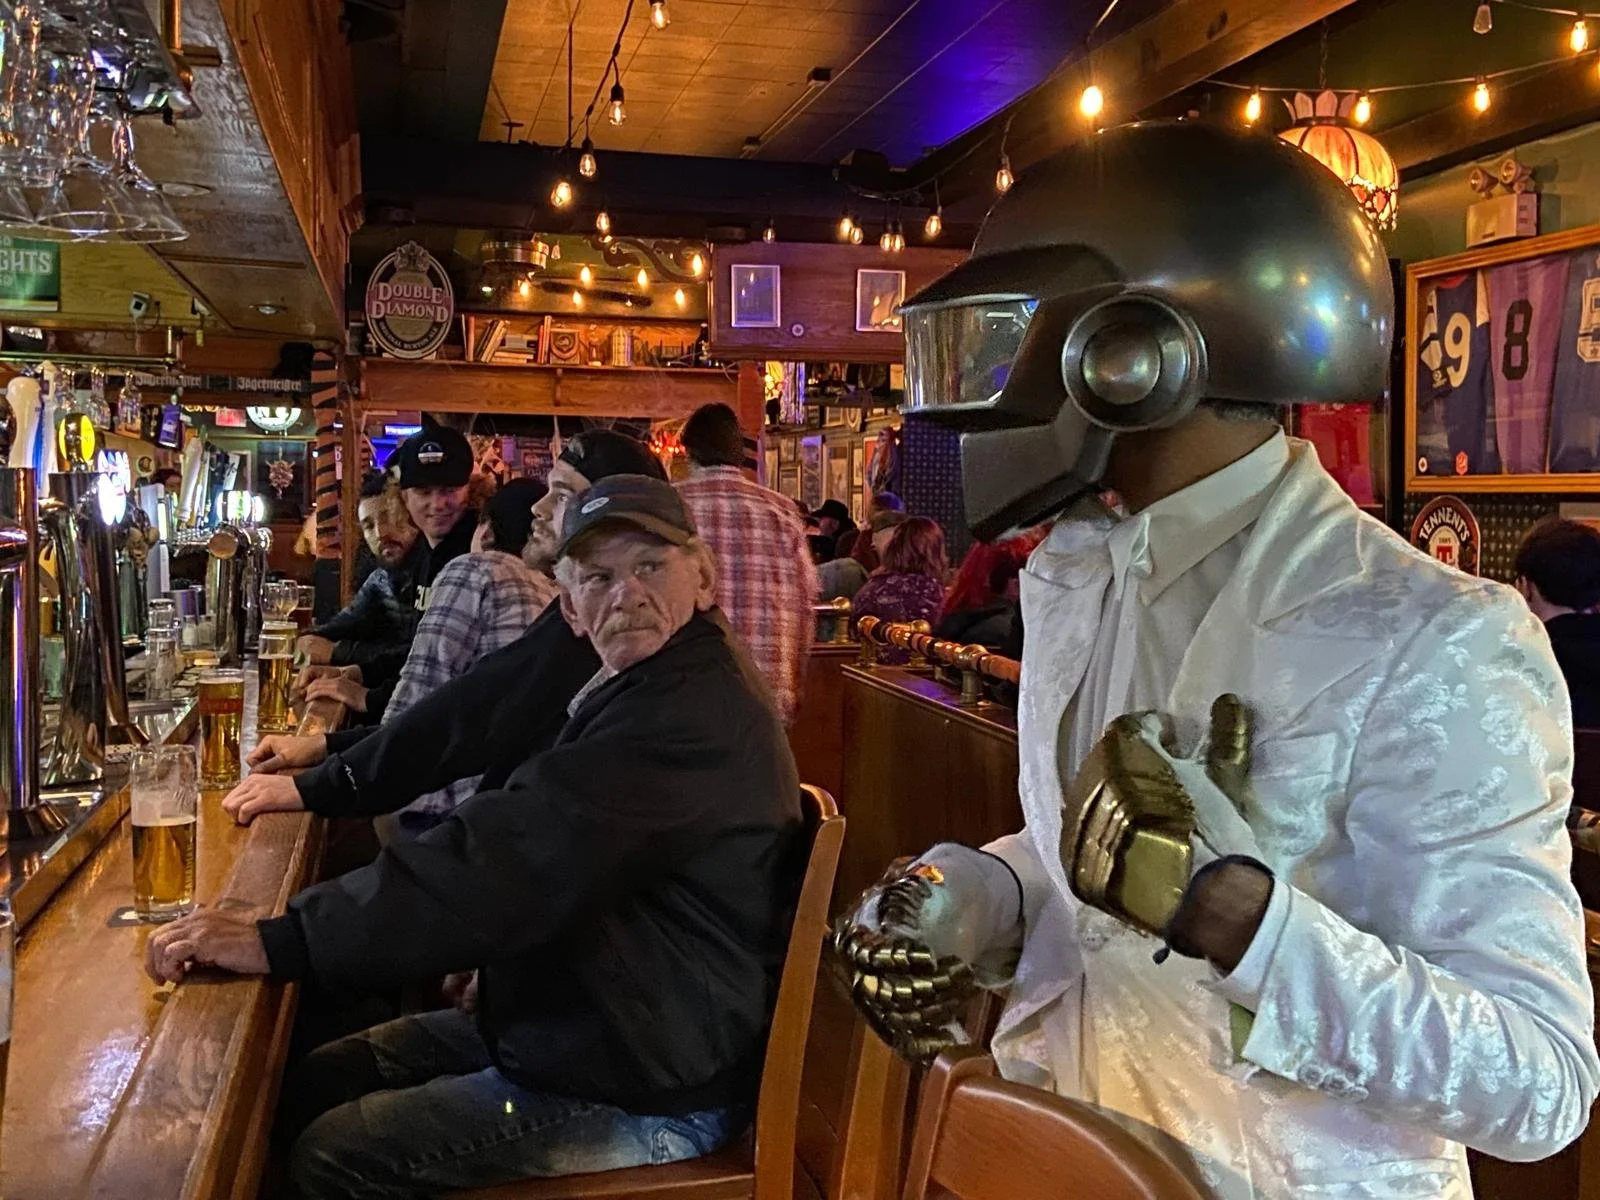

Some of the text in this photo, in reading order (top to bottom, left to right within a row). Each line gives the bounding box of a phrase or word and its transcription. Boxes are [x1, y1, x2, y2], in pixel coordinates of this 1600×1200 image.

[370, 300, 449, 322] DIAMOND
[378, 282, 443, 304] DOUBLE
[1444, 311, 1471, 388] 9
[1502, 299, 1533, 381] 8
